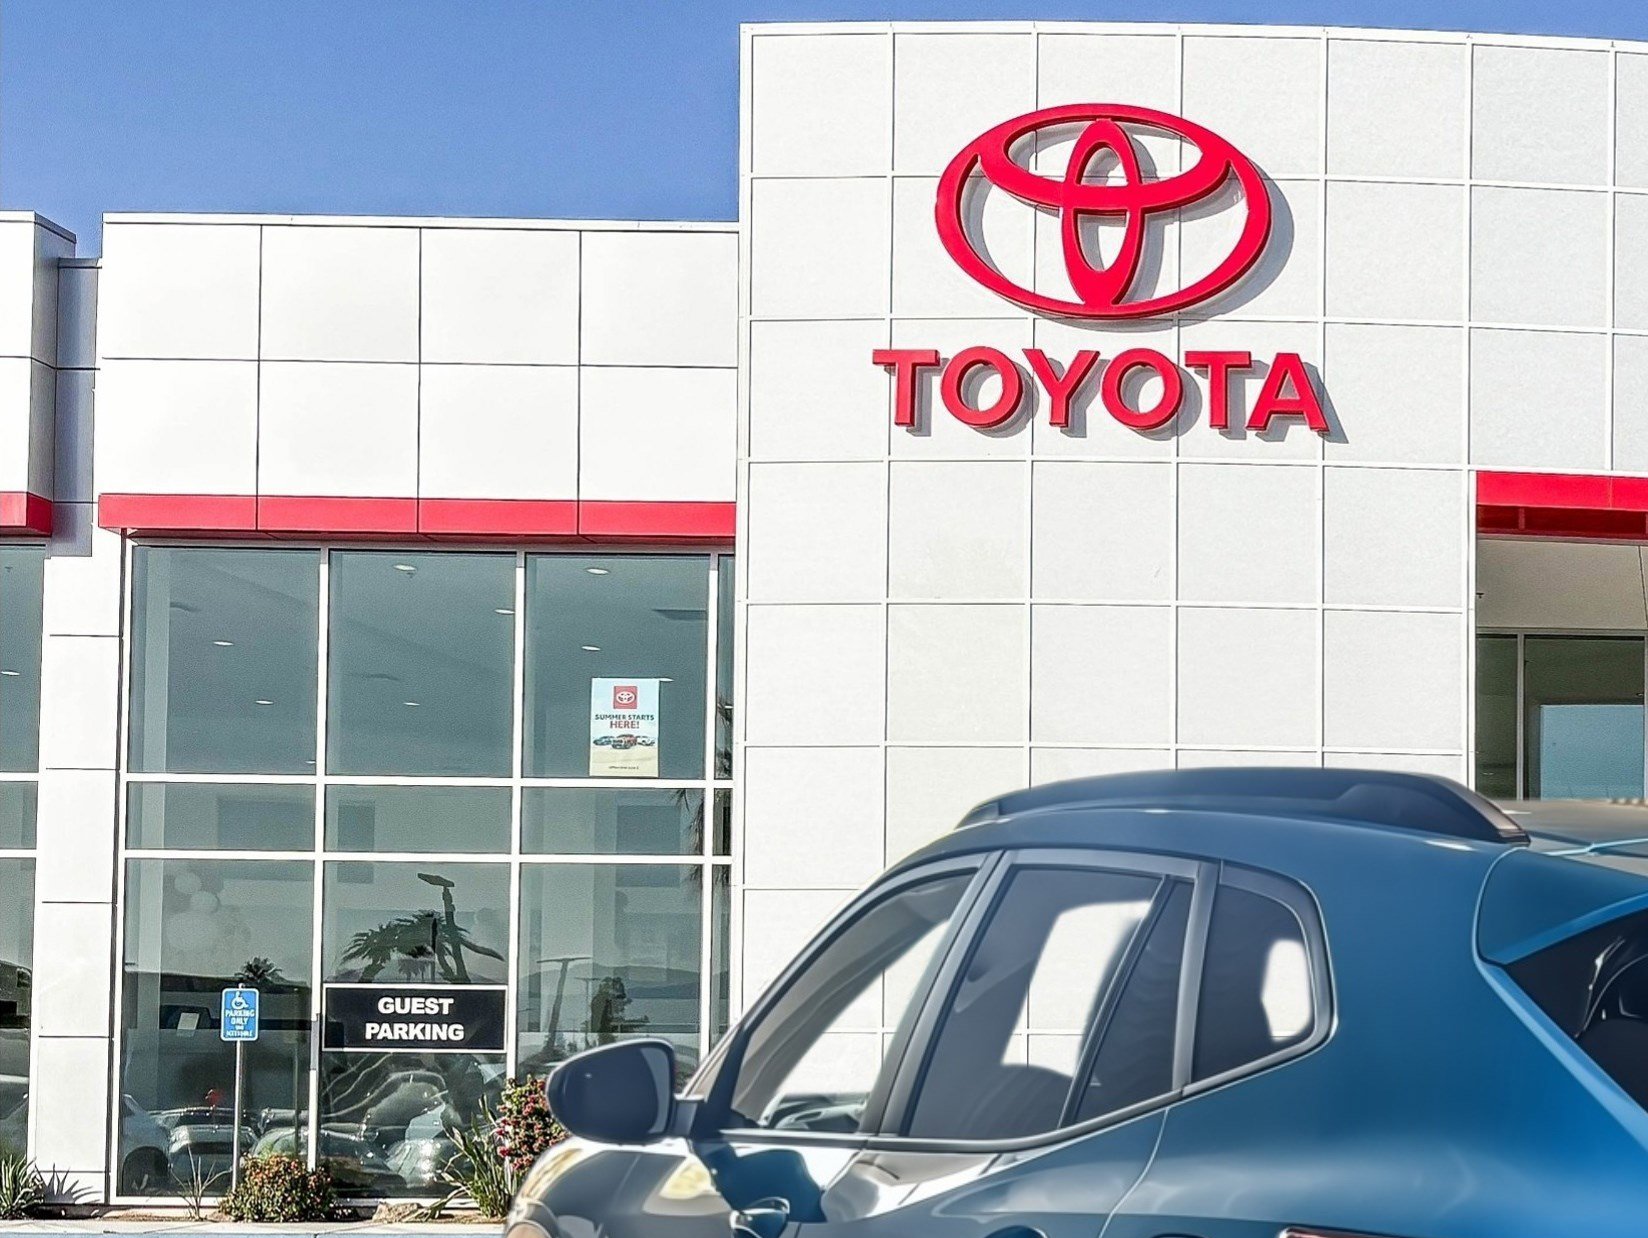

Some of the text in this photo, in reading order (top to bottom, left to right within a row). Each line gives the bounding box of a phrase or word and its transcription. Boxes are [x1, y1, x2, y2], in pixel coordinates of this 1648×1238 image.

[873, 346, 1329, 432] TOYOTA
[609, 720, 640, 729] HERE!
[377, 997, 454, 1015] GUEST
[365, 1022, 465, 1041] PARKING
